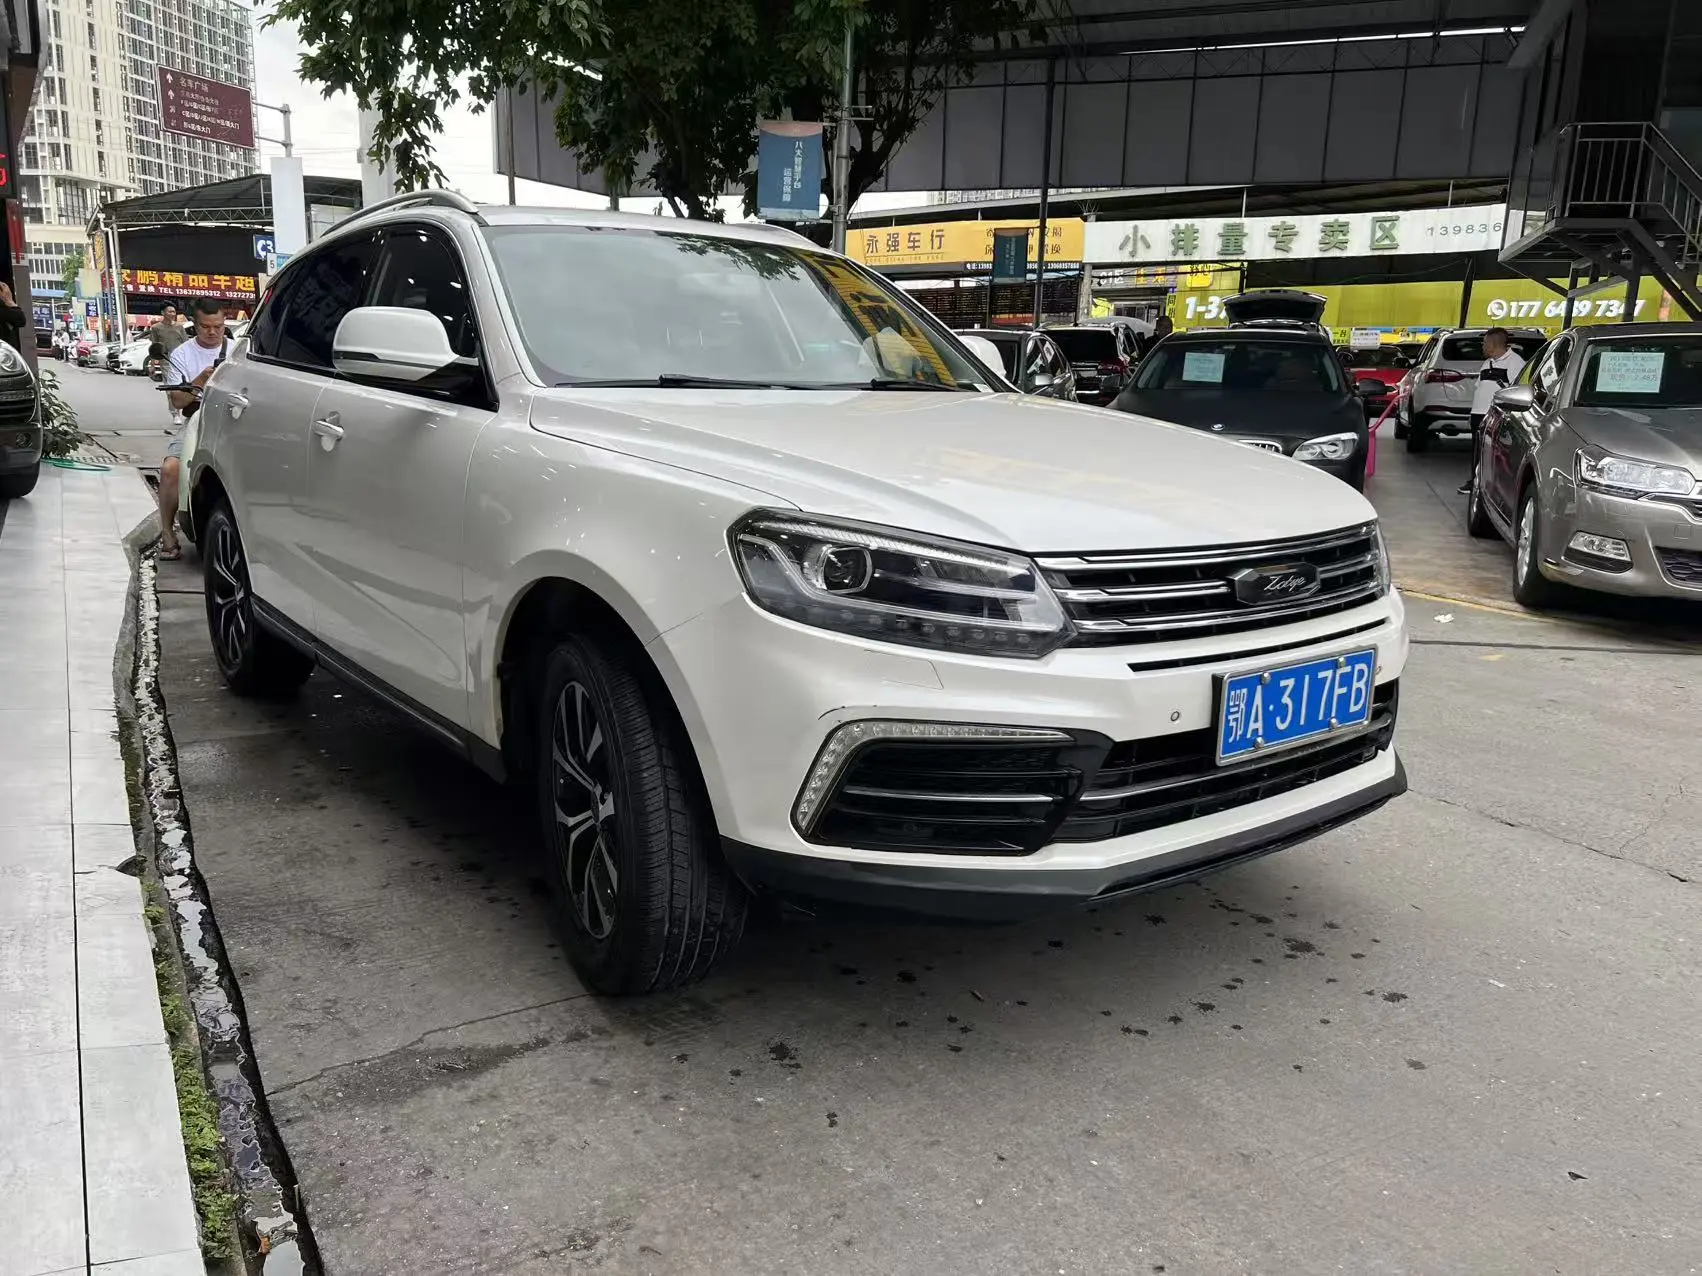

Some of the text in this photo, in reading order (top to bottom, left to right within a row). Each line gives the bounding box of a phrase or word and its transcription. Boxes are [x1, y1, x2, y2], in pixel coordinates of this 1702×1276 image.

[866, 228, 945, 254] 永强车行
[1119, 215, 1503, 258] 小排量专卖区 139836
[1509, 300, 1543, 318] 177
